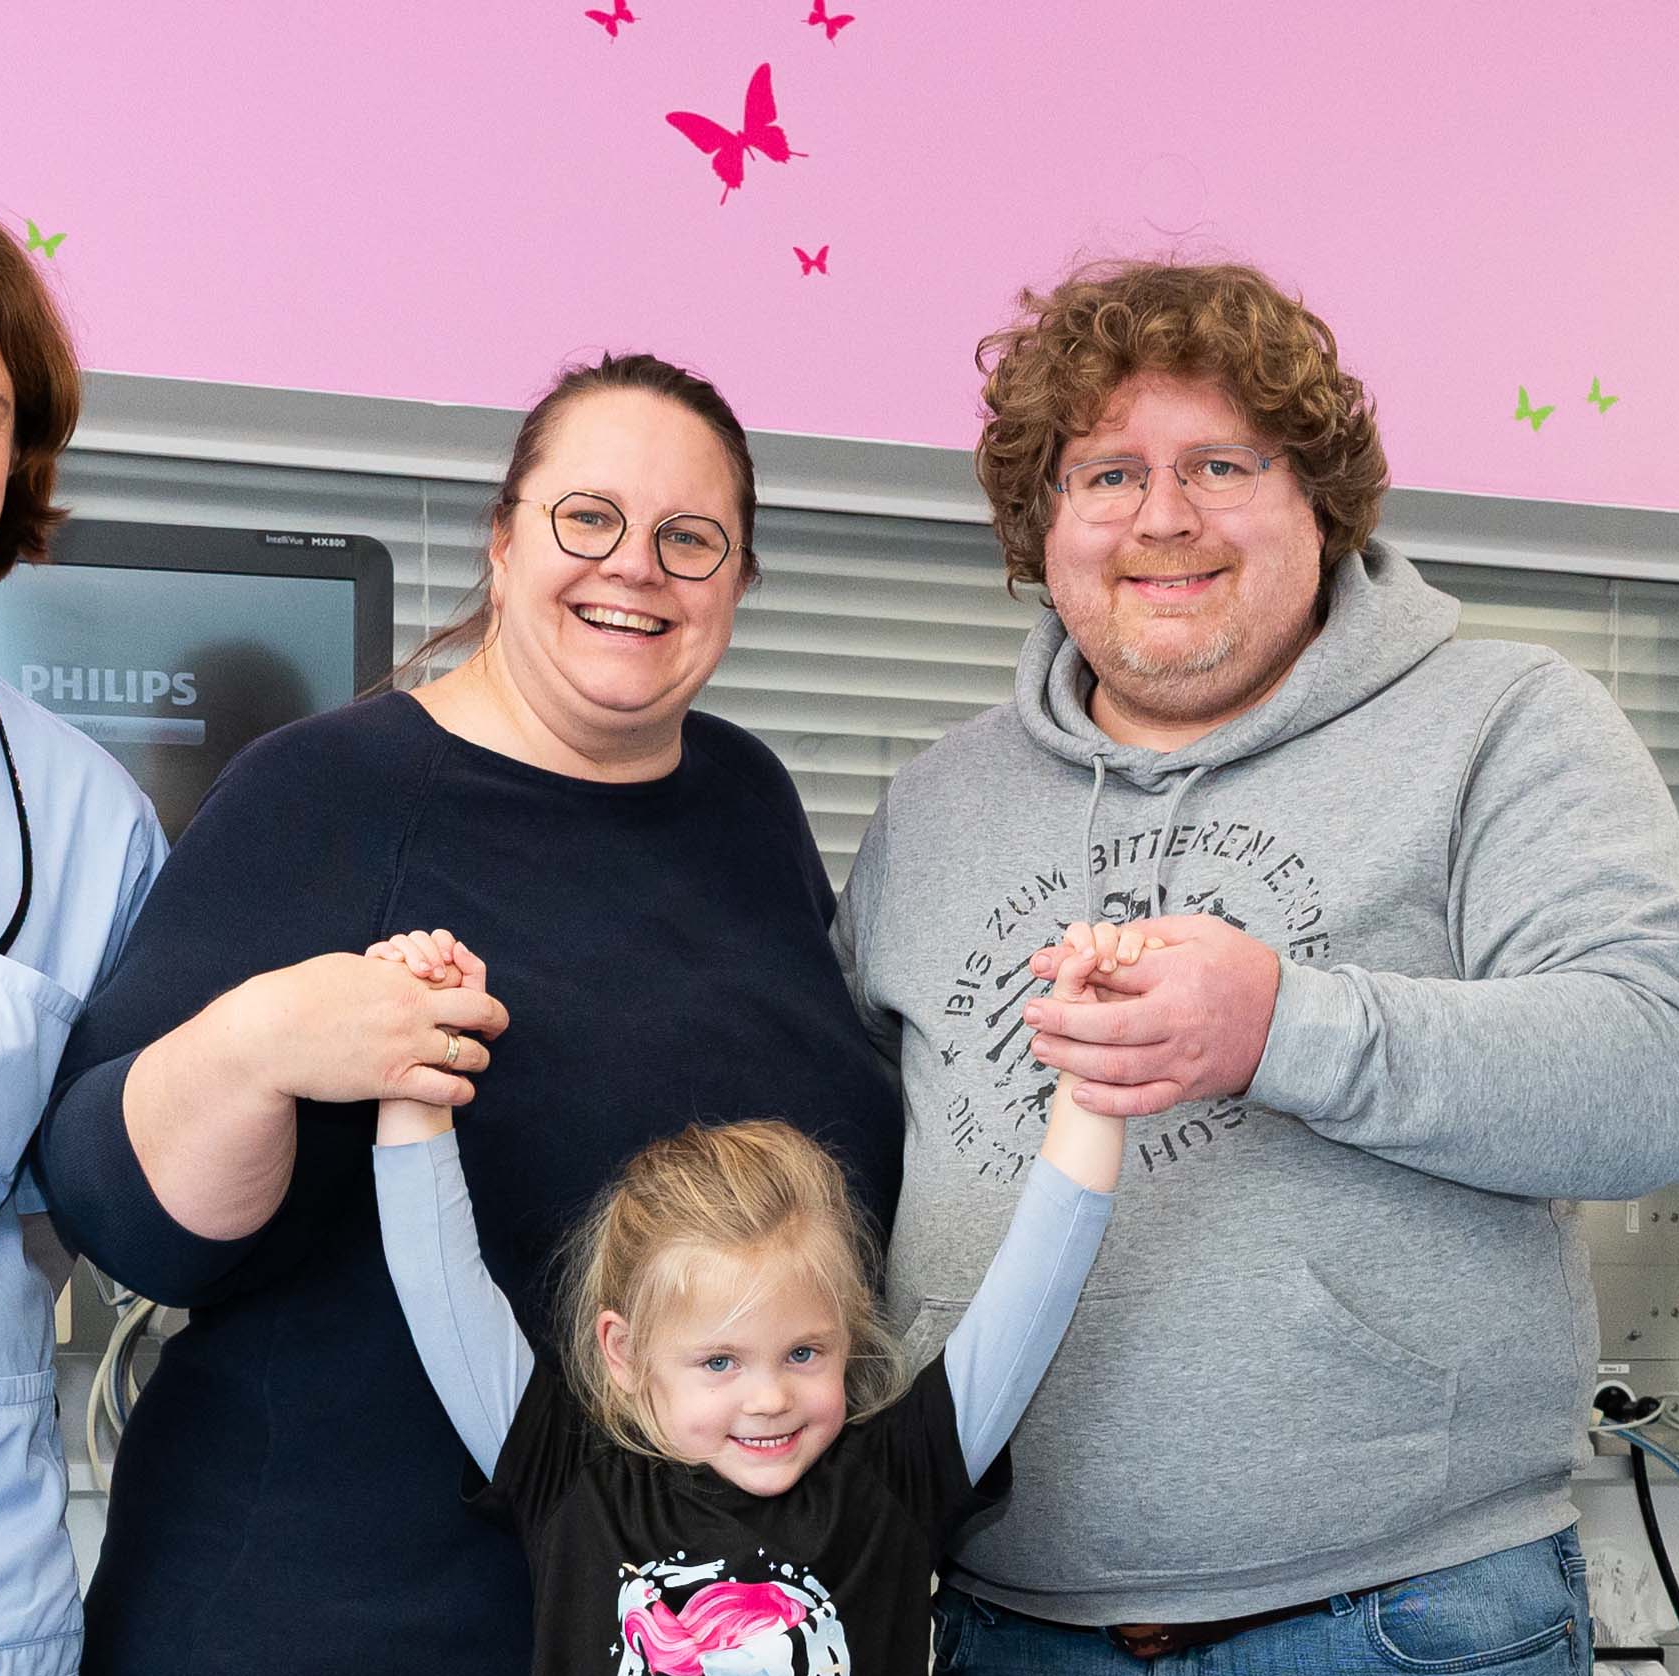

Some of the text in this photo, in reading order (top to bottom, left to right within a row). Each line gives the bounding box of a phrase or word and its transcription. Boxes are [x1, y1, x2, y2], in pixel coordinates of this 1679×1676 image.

[311, 537, 346, 548] MX800
[21, 664, 197, 706] PHILIPS
[944, 950, 992, 1017] BIS
[986, 864, 1068, 941] ZUM
[1090, 820, 1275, 878] BITTEREN
